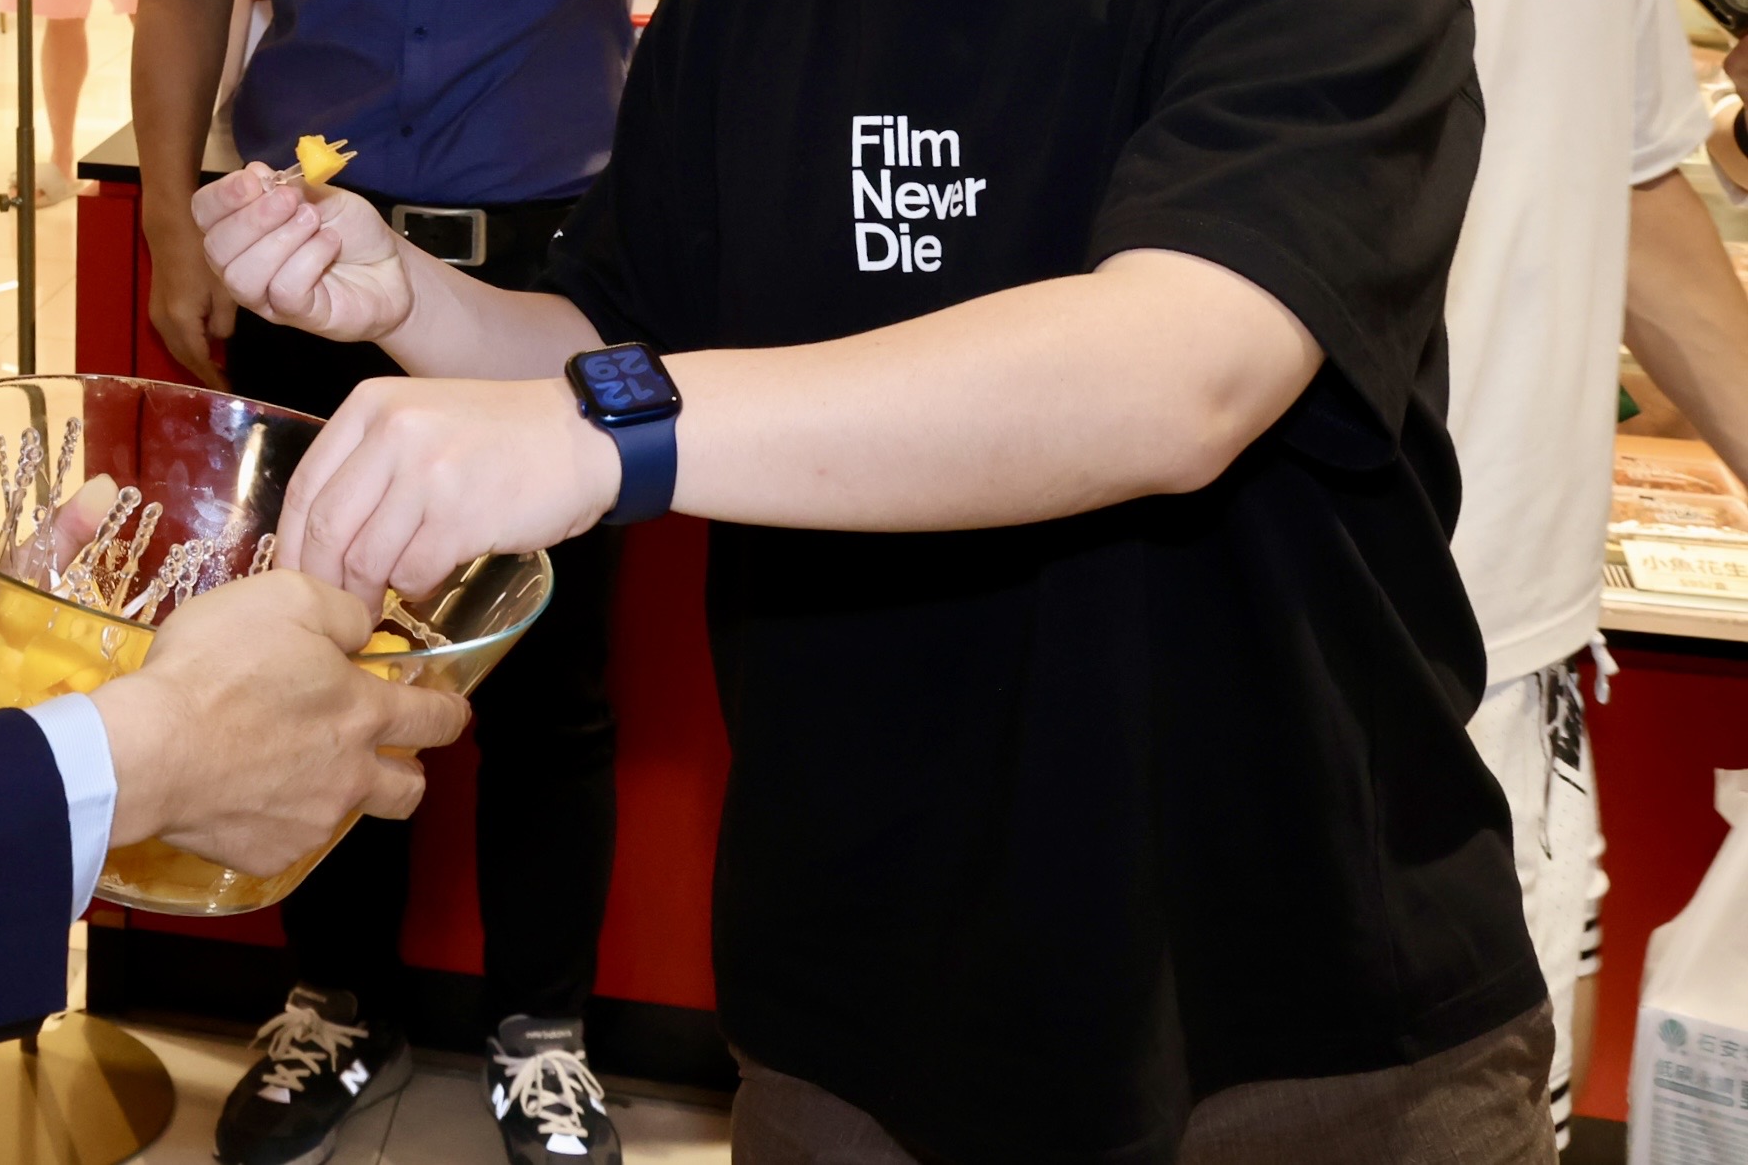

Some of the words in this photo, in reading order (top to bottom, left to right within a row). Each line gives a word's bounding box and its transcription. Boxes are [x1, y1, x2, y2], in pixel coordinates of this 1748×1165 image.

[852, 115, 960, 167] Film
[852, 168, 987, 220] Never
[855, 222, 942, 273] Die
[1641, 554, 1747, 578] 小魚花生
